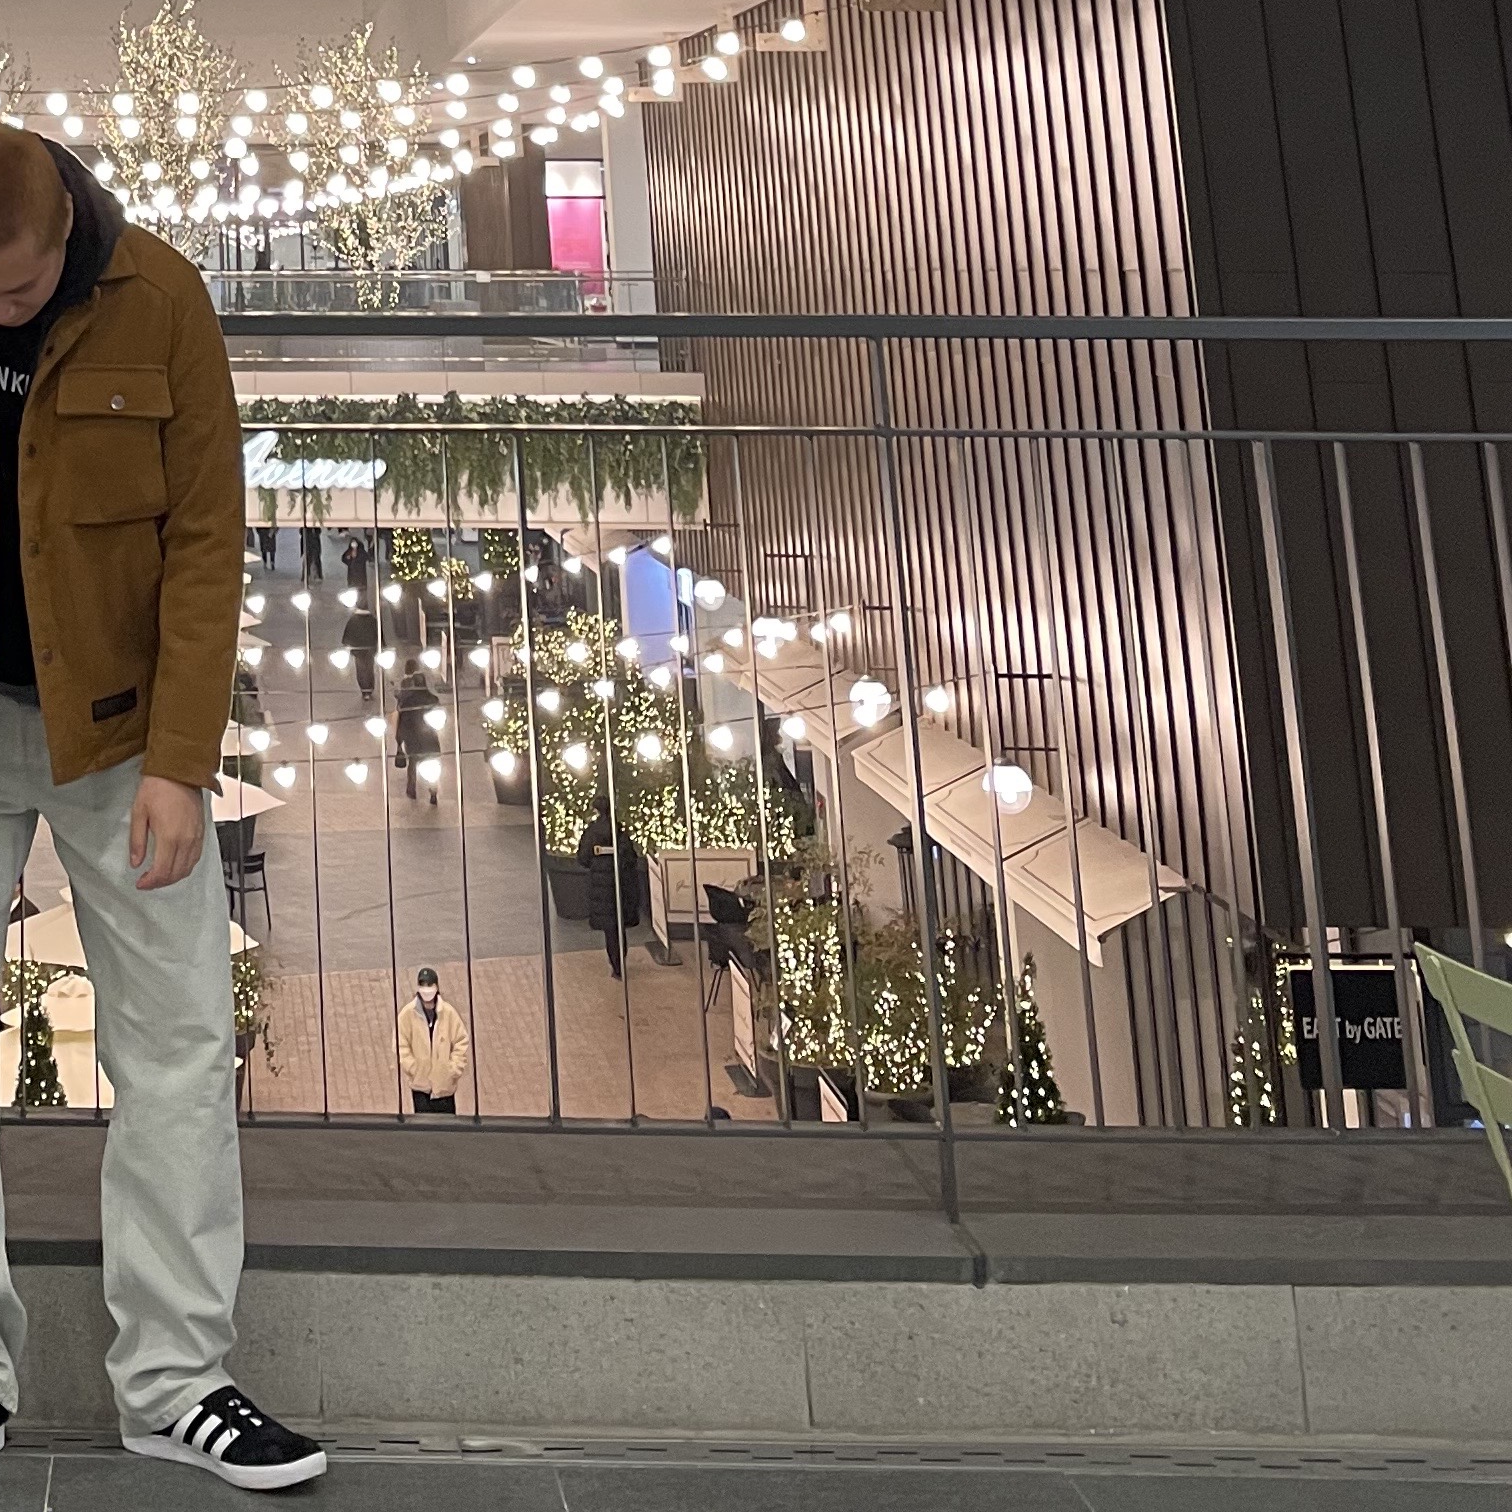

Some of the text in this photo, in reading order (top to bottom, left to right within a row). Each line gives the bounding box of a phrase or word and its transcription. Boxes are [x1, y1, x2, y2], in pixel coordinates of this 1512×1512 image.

[1302, 1016, 1404, 1044] EAT by GATE
